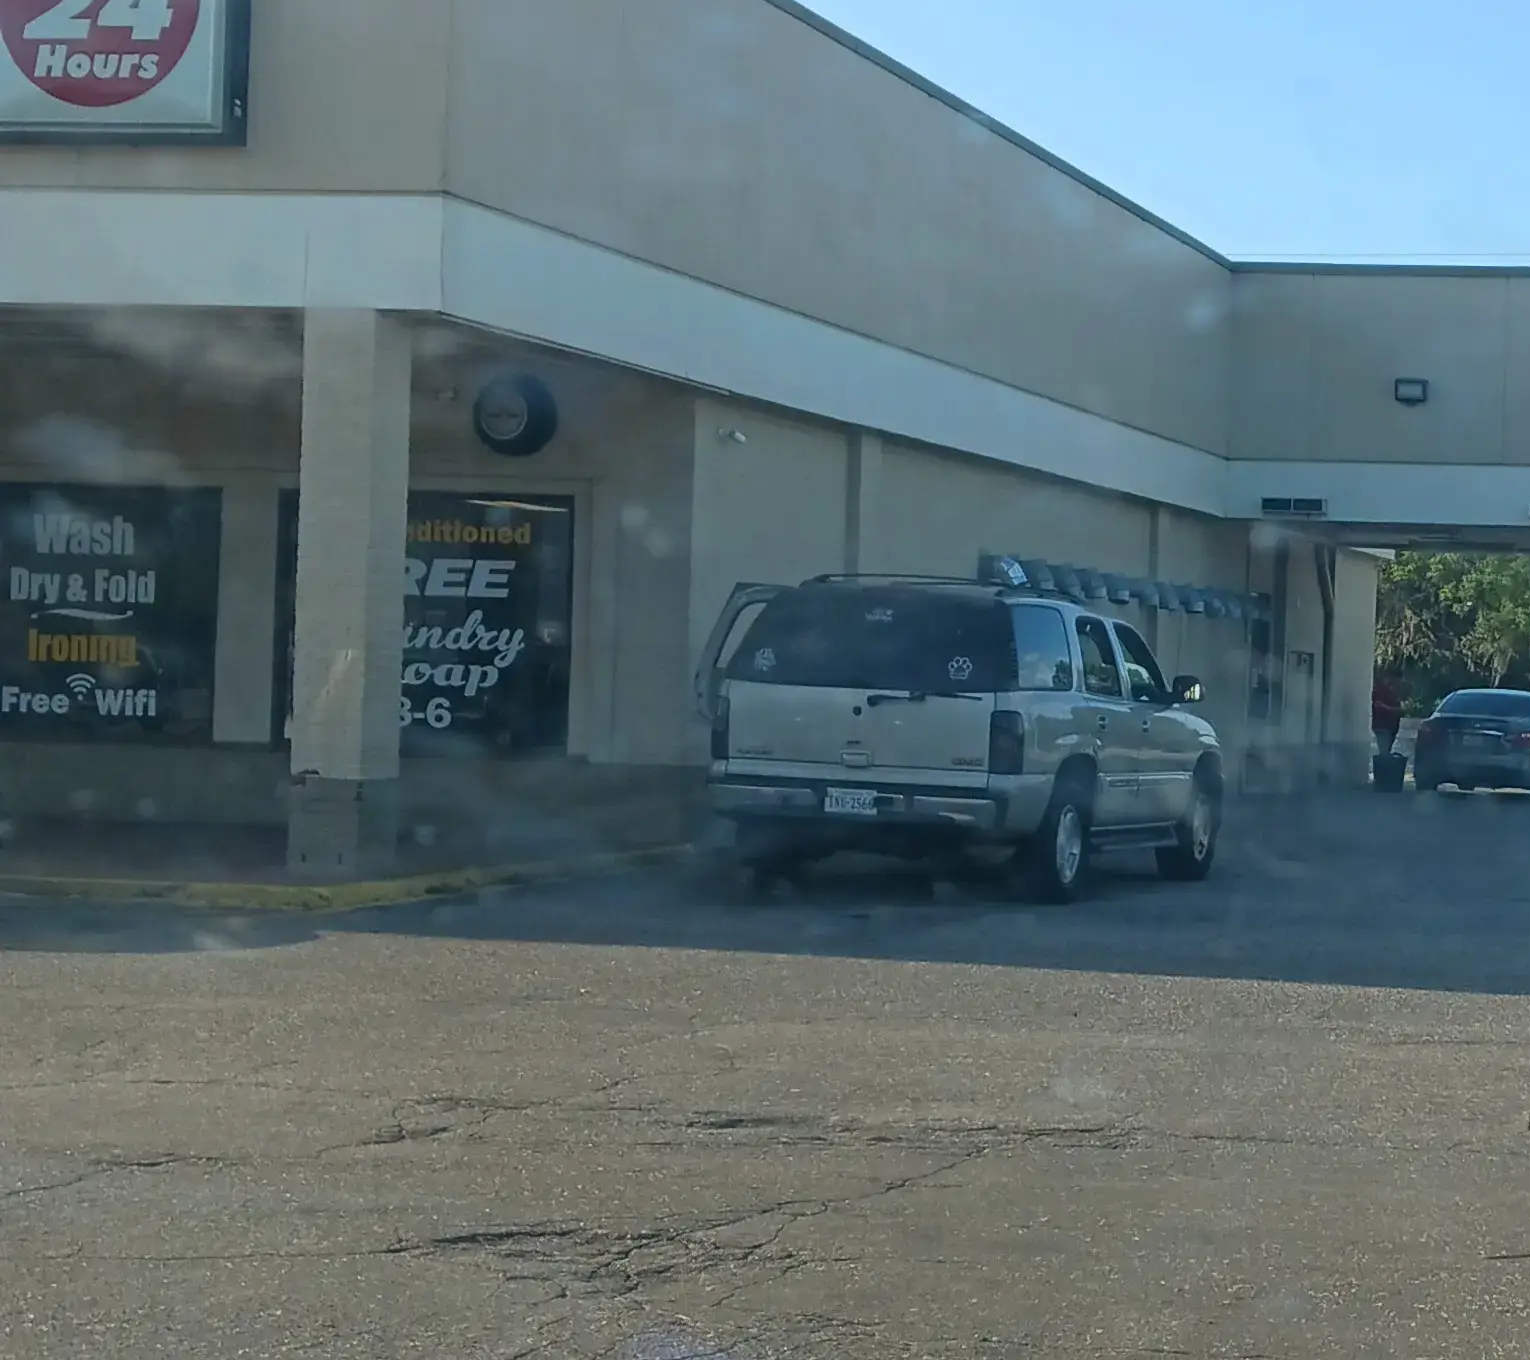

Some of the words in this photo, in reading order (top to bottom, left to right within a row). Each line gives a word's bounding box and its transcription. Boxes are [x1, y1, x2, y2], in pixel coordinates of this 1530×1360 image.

[34, 45, 159, 78] Hours
[33, 513, 134, 555] Wash
[407, 519, 531, 544] ditioned
[10, 566, 61, 604] Dry
[66, 574, 88, 602] &
[94, 569, 155, 604] Fold
[403, 558, 516, 598] REE
[28, 628, 140, 668] Ironing
[401, 662, 499, 697] oap
[1, 686, 70, 714] Free
[95, 688, 156, 717] Wifi
